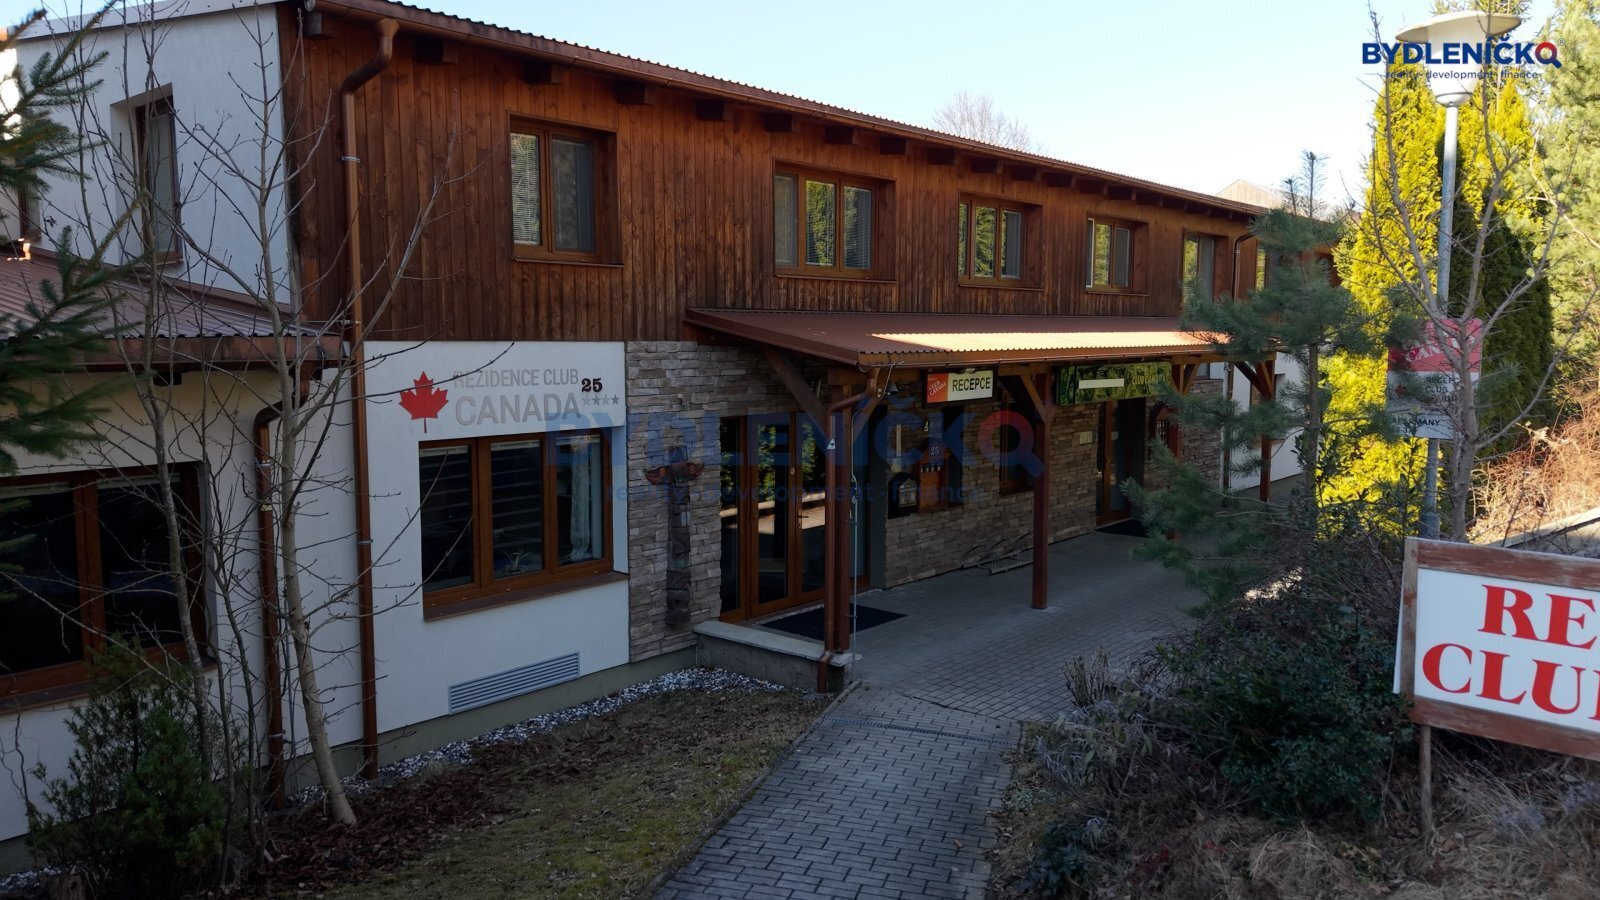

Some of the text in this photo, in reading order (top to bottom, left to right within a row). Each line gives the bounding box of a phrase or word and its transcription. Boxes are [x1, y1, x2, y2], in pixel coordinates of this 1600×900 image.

[453, 368, 579, 389] REZIDENCE CLUB
[581, 377, 603, 393] 25
[952, 377, 991, 392] RECEPCE
[455, 392, 582, 426] CANADA
